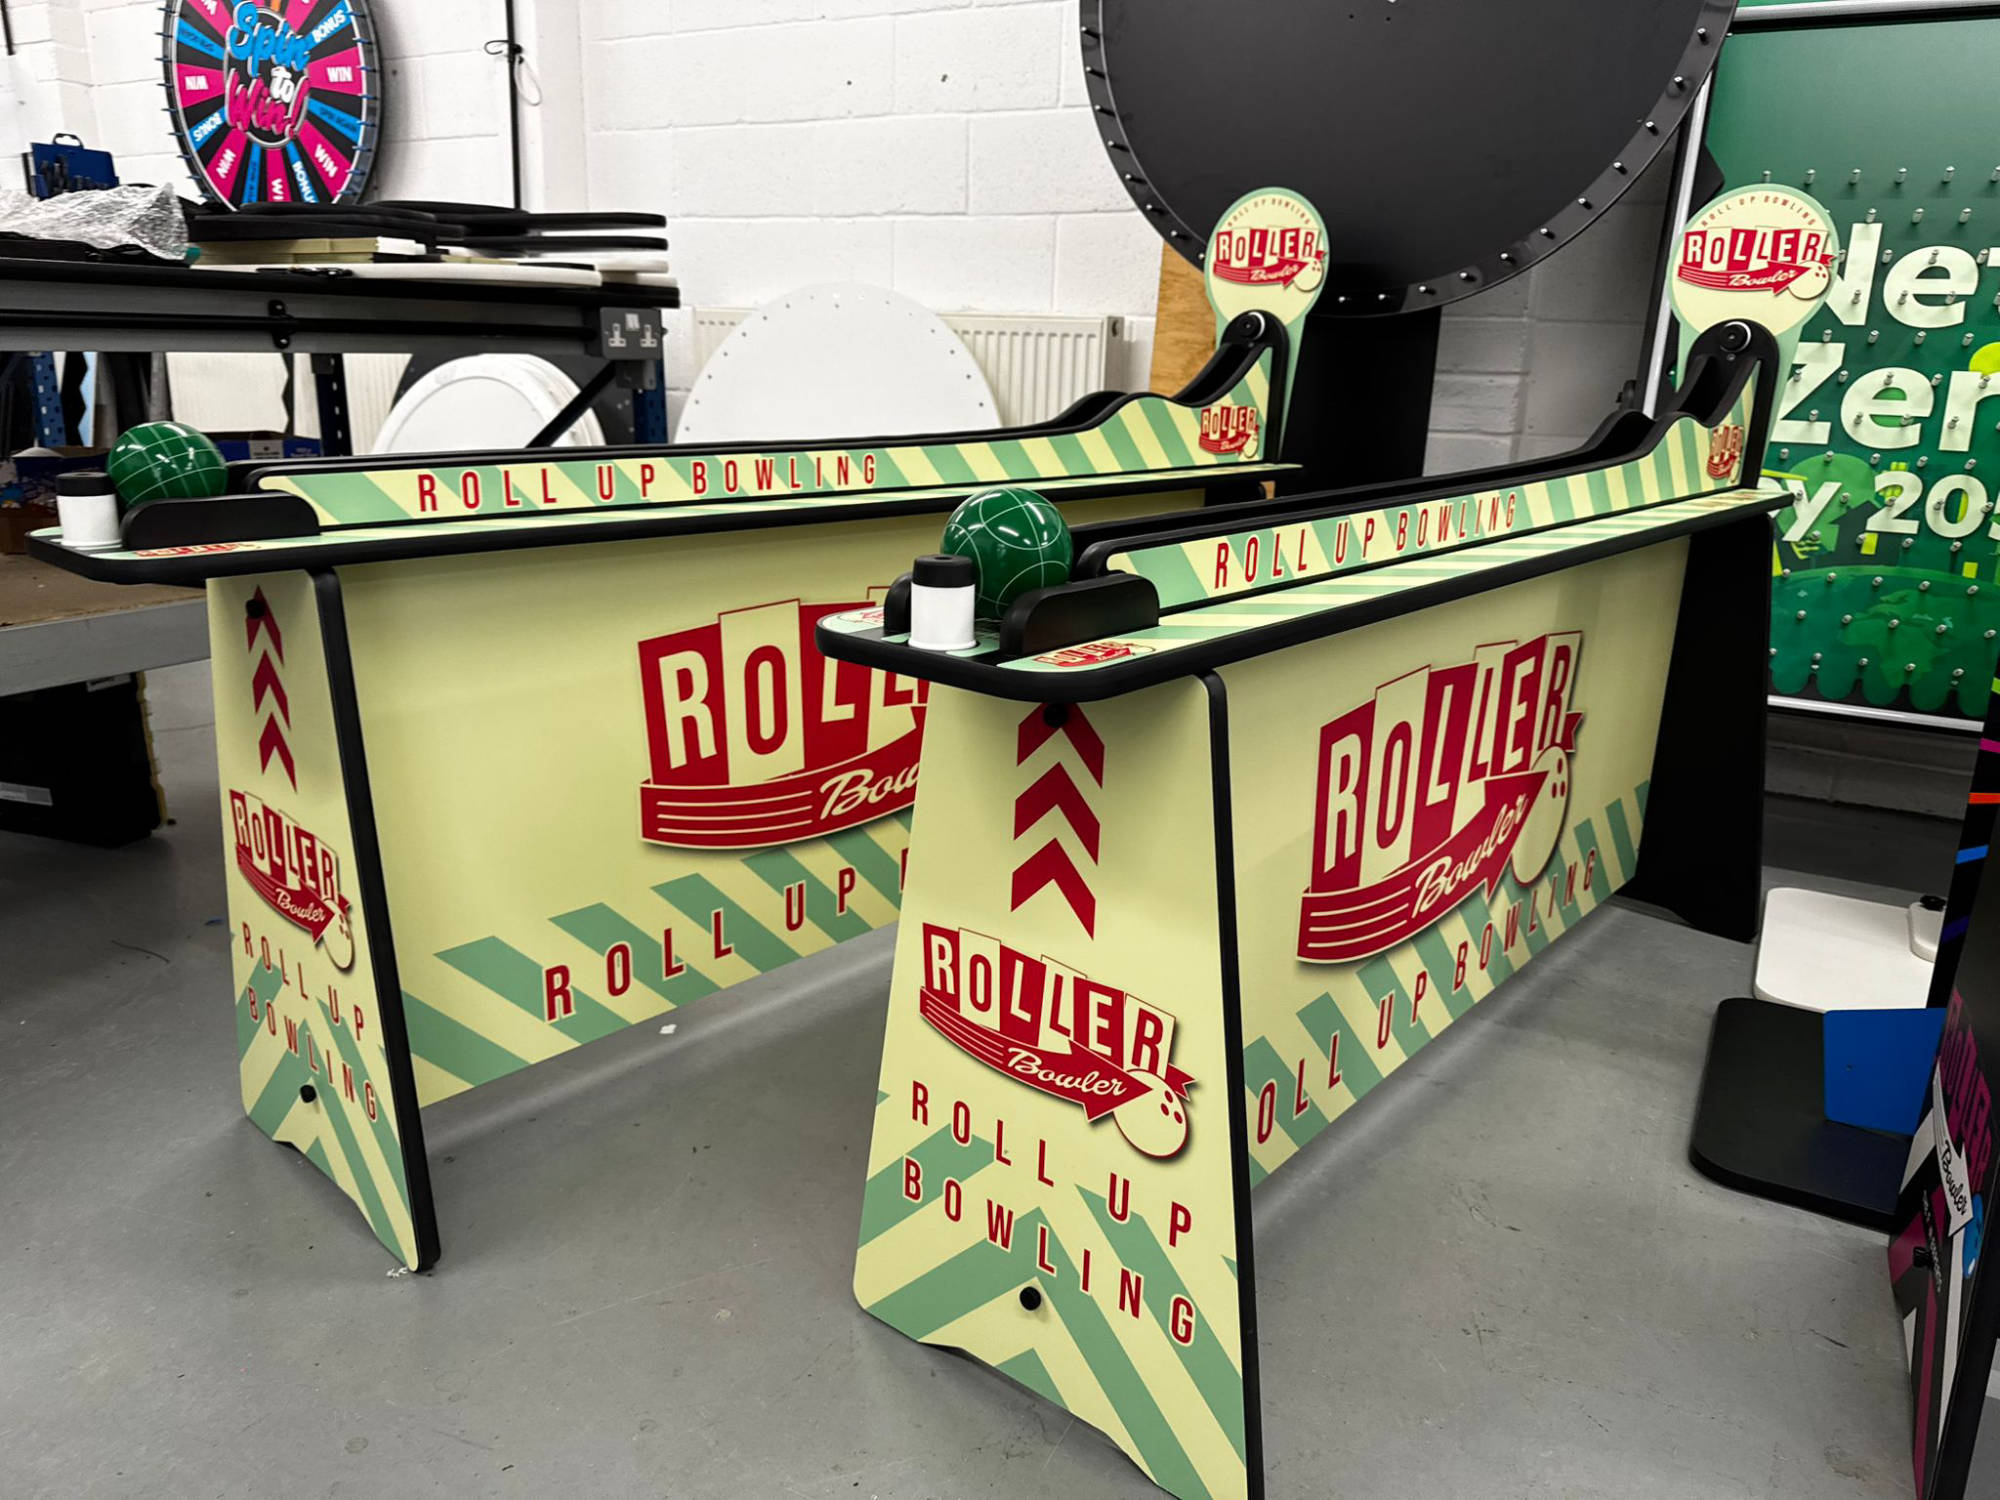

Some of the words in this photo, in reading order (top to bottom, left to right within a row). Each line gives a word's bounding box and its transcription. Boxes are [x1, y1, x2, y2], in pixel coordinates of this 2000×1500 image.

[226, 1, 310, 78] Spin
[312, 10, 346, 42] BONUS
[226, 68, 310, 139] Win!
[270, 66, 294, 103] to
[326, 66, 353, 82] WIN
[216, 149, 236, 179] WIN
[271, 178, 284, 200] WI
[292, 161, 316, 203] BONU
[314, 144, 338, 178] WIN
[1217, 229, 1316, 262] ROLLER
[1685, 231, 1821, 265] ROLLER
[1825, 223, 2000, 328] Ne
[1728, 269, 1797, 286] Bowler
[1202, 408, 1256, 434] ROLLER
[417, 468, 557, 512] ROLL
[598, 463, 655, 501] UP
[693, 454, 876, 494] BOWLING
[1757, 477, 1841, 541] y
[1214, 529, 1308, 589] ROLL
[1335, 518, 1375, 564] UP
[1396, 494, 1516, 551] BOWLING
[1324, 644, 1573, 874] ROLLER
[820, 763, 919, 820] Bow
[232, 798, 335, 902] ROLLER
[1412, 793, 1528, 918] Bowler
[275, 887, 325, 922] Bowler
[545, 910, 732, 1021] ROLL
[785, 867, 855, 931] UP
[242, 921, 308, 1001] ROLL
[328, 984, 364, 1041] UP
[930, 934, 1165, 1082] ROLLER
[1257, 1034, 1342, 1144] OLL
[1377, 971, 1427, 1049] UP
[1454, 849, 1596, 991] BOWLING
[248, 986, 377, 1121] BOWLING
[1008, 1046, 1127, 1097] Bowler
[912, 1081, 1054, 1187] ROLL
[1109, 1172, 1192, 1247] UP
[904, 1158, 1194, 1344] BOWLING
